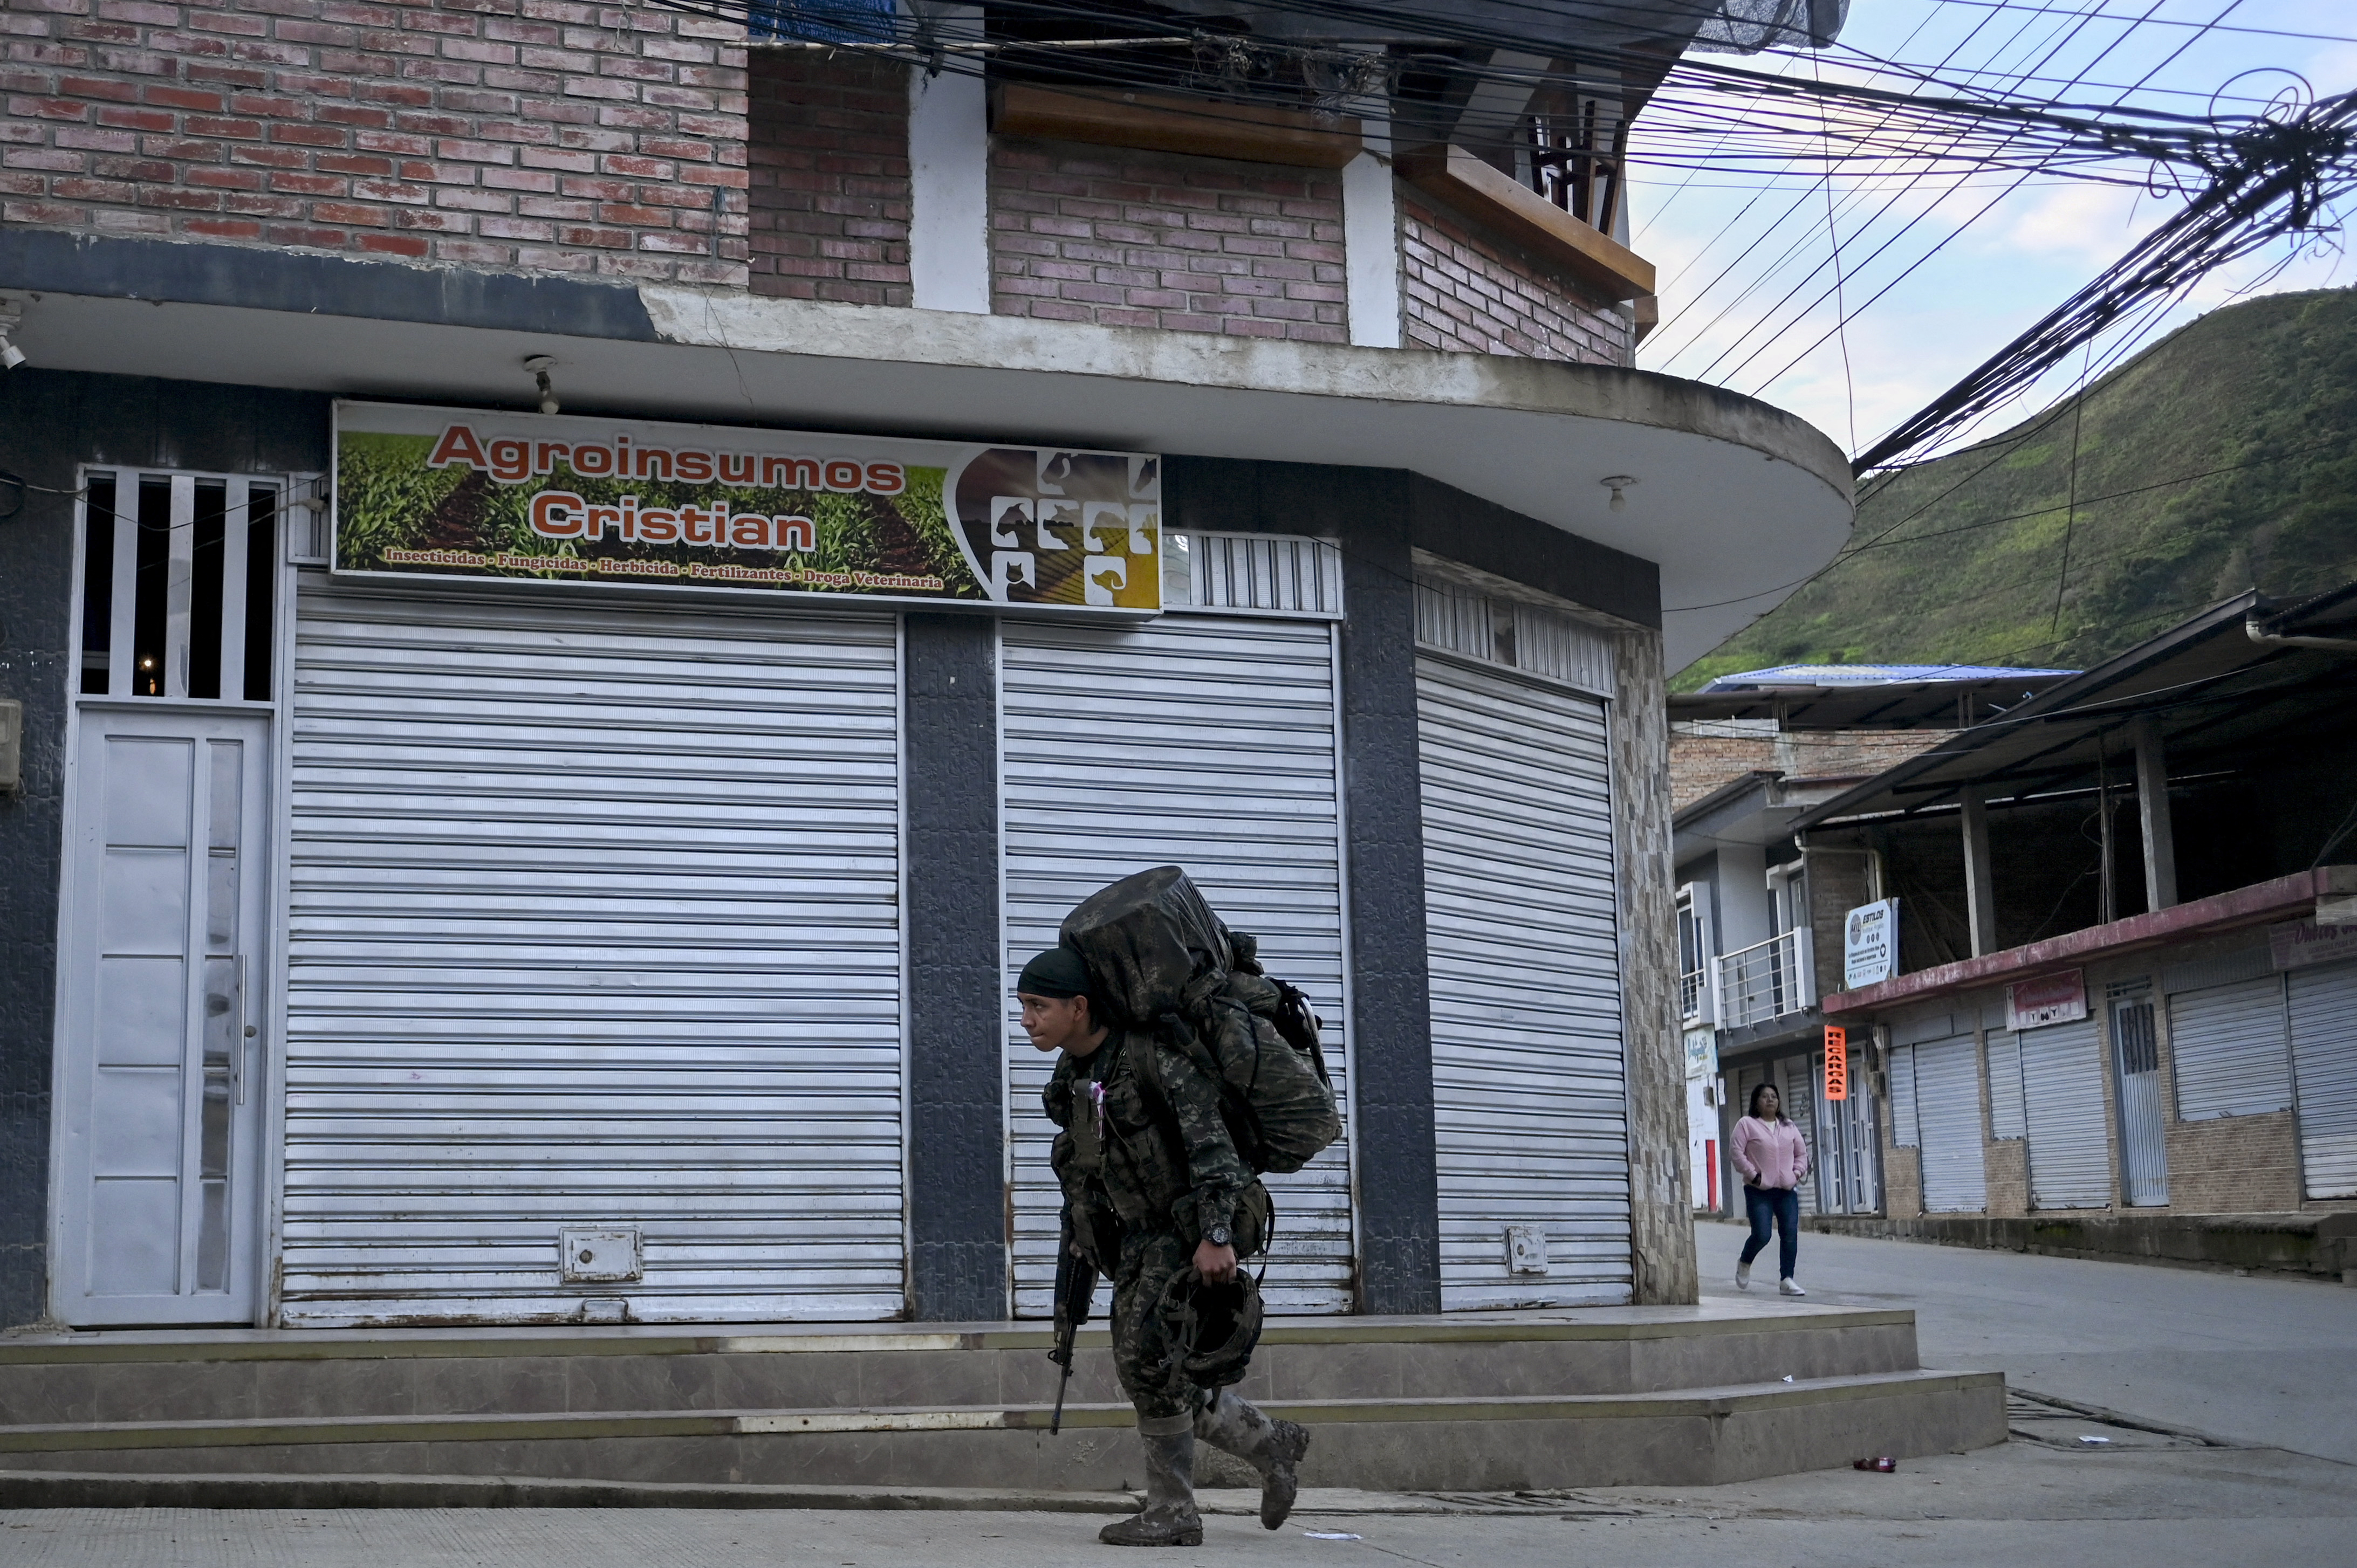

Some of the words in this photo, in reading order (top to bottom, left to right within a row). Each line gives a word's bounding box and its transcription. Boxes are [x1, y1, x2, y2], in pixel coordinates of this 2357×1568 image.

[431, 425, 903, 491] Agroinsumos
[533, 494, 812, 548] Cristian
[385, 548, 485, 565] Insecticidas
[498, 554, 587, 570] Fungicidas
[599, 559, 679, 575] Herbicida
[691, 564, 791, 580] Fertilizantes
[803, 569, 850, 586] Droga
[854, 572, 942, 588] Veterinaria
[1850, 921, 1860, 935] MIL
[1862, 909, 1884, 924] ESTILOS
[1827, 1031, 1844, 1094] RECARGAS
